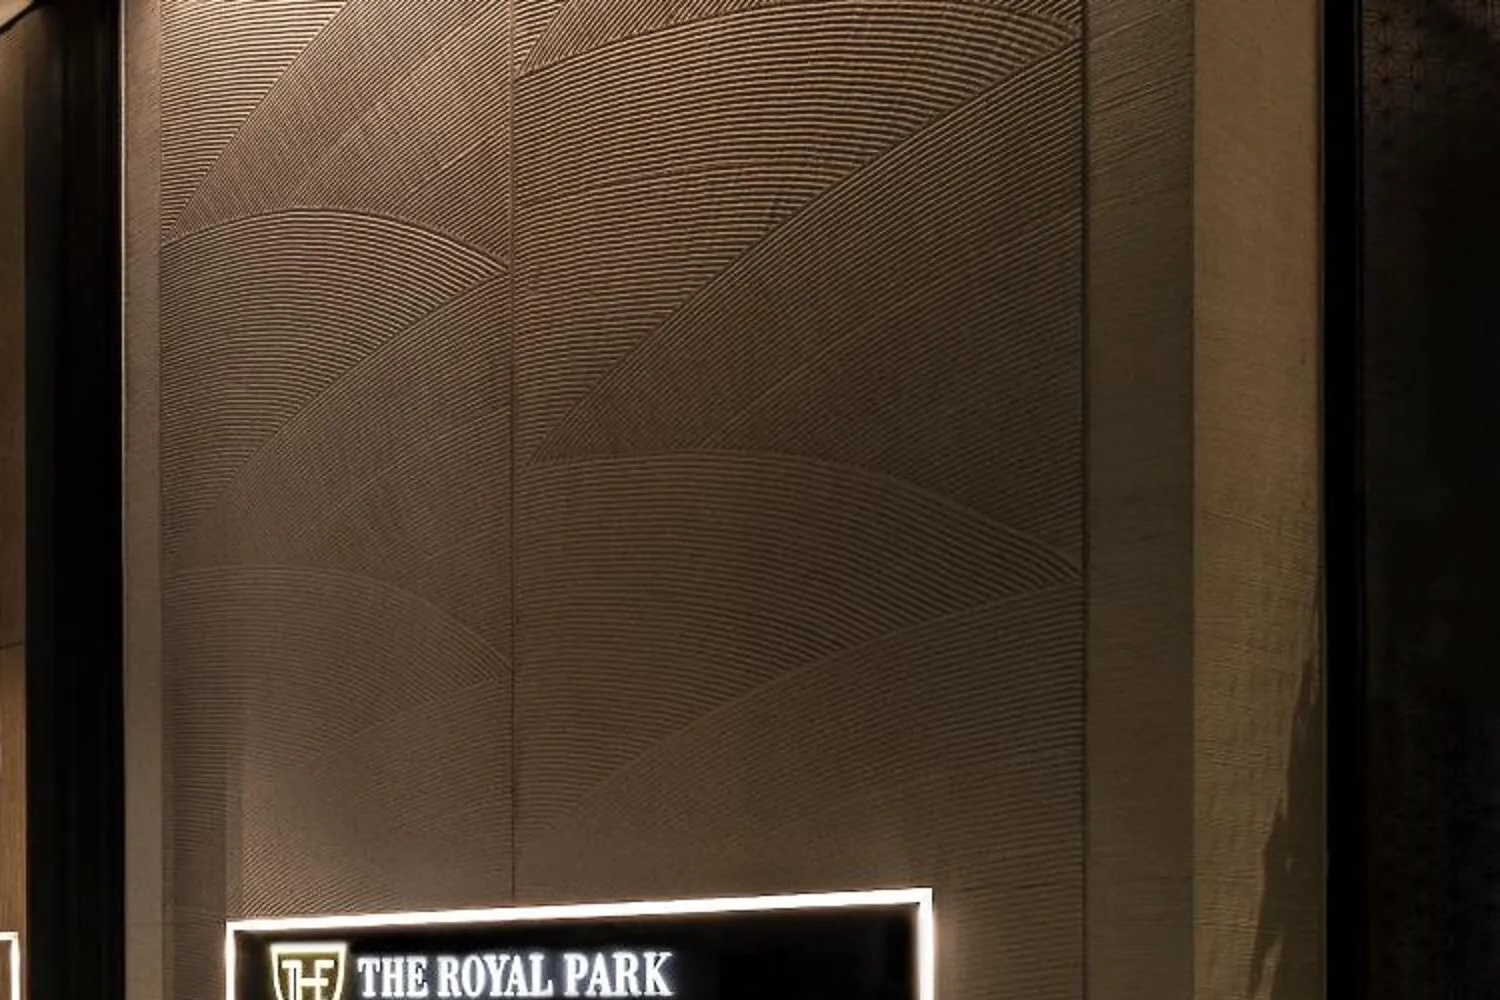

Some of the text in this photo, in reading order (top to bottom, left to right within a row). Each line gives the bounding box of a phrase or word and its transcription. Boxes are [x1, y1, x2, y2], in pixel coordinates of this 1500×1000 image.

[356, 951, 675, 998] THE ROYAL PARK
